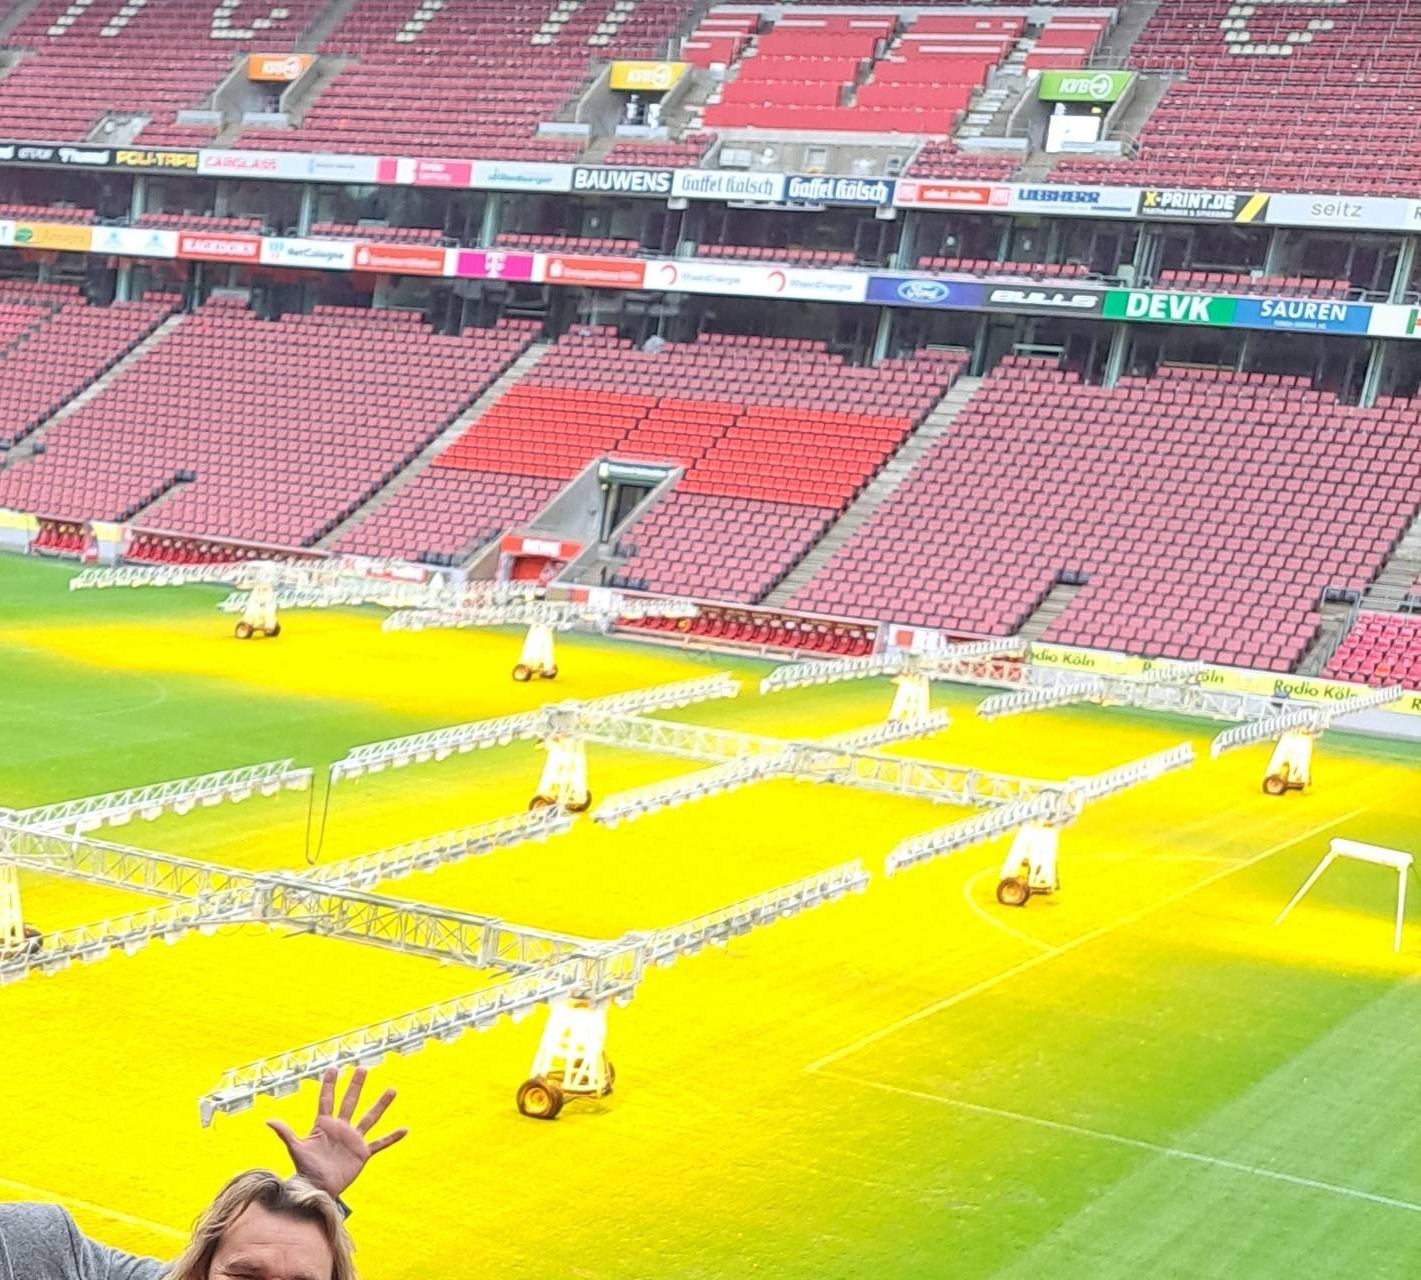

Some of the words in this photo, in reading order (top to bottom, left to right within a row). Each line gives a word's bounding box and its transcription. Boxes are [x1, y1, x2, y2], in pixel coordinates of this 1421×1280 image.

[1059, 78, 1090, 93] KVB
[575, 169, 670, 192] BAUWENS
[682, 174, 723, 193] Gaffel
[726, 176, 773, 196] Kölsch
[789, 177, 833, 199] Gaffel
[835, 180, 889, 204] Kölsch
[1143, 191, 1237, 210] X-PRINT.DE
[1310, 201, 1363, 217] seitz
[990, 289, 1099, 308] BULLS
[1126, 292, 1213, 322] DEVK
[1260, 300, 1348, 321] SAUREN
[1031, 647, 1058, 663] adio
[1063, 651, 1095, 667] Köln
[1200, 668, 1225, 683] öln
[1273, 679, 1319, 697] Radio
